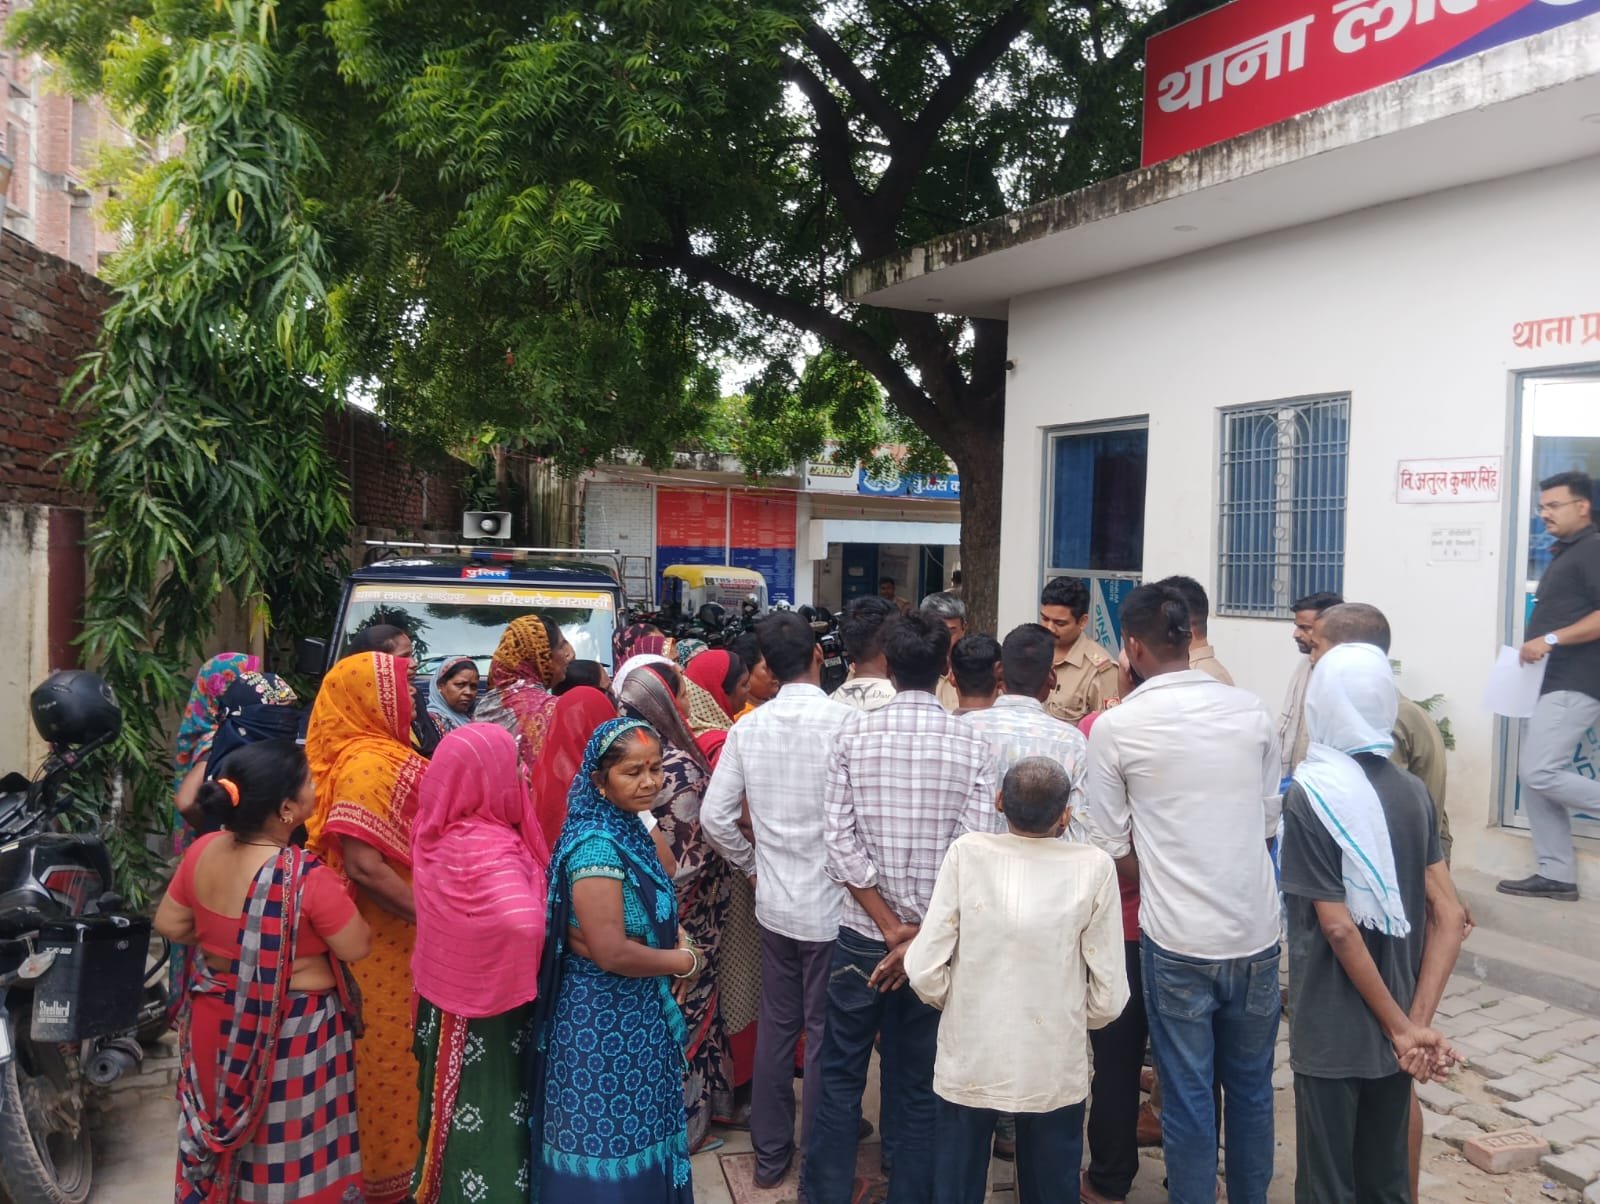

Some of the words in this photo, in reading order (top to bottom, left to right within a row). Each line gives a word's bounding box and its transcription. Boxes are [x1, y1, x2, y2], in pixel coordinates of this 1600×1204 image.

[1157, 14, 1315, 113] थाना
[1512, 315, 1576, 349] थाना
[1579, 312, 1600, 345] प्र
[1415, 472, 1447, 495] अतुल
[1450, 471, 1478, 495] कुमार
[1479, 466, 1497, 491] सिंह
[465, 568, 508, 578] पुलिस
[39, 1000, 71, 1018] Steelbird
